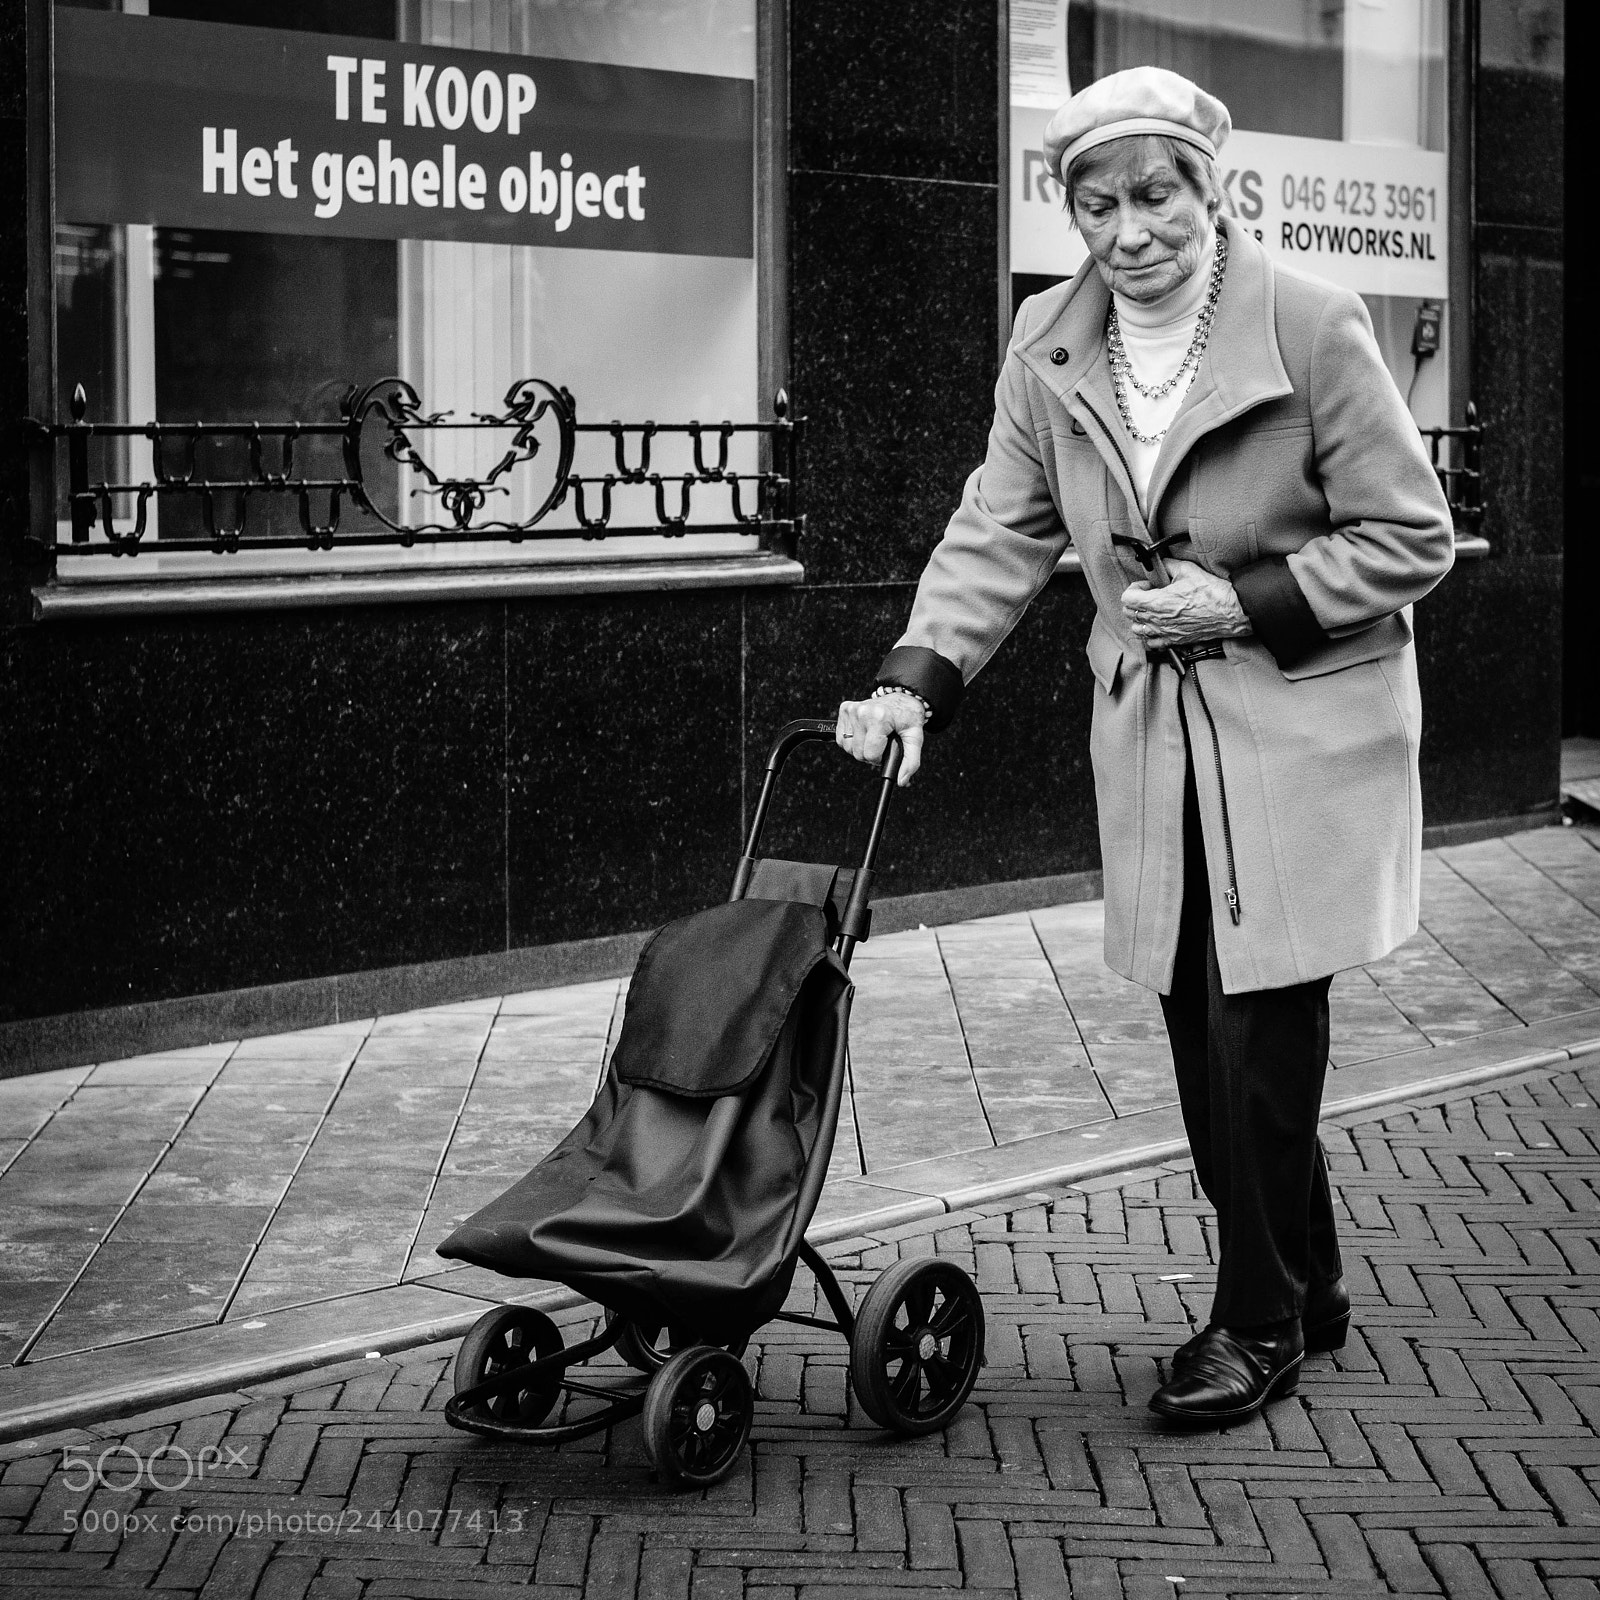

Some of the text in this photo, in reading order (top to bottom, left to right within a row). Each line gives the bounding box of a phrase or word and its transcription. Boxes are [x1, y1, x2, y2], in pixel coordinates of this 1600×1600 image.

[327, 55, 538, 135] TE KOOP
[202, 126, 646, 233] Het gehele object
[1282, 174, 1326, 213] 046
[1333, 179, 1377, 217] 423
[1384, 183, 1437, 223] 3961
[1282, 221, 1436, 261] ROYWORKS.NL
